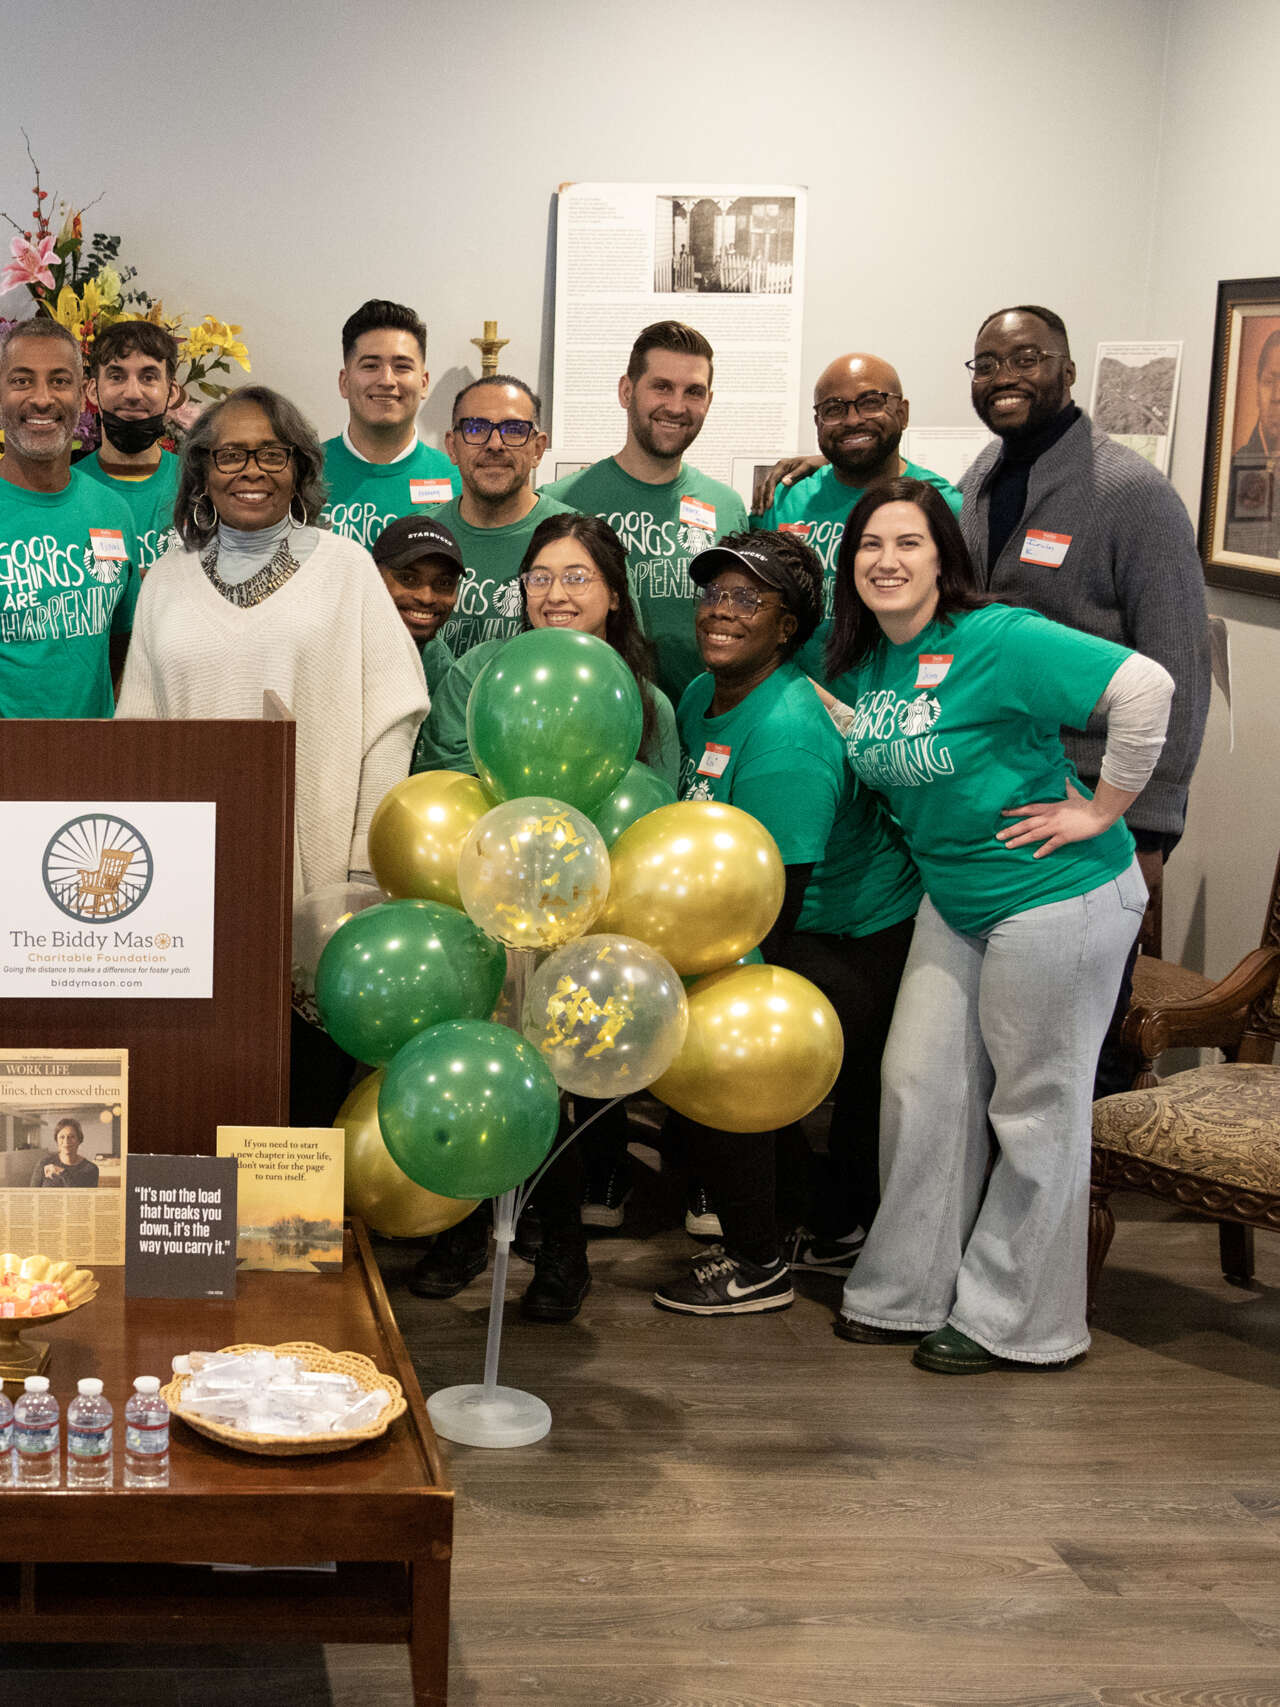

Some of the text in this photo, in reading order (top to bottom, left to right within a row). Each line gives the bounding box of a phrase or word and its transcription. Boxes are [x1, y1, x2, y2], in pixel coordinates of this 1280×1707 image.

[407, 531, 453, 547] STARBUCKS
[3, 591, 41, 612] ARE
[10, 931, 185, 951] The Biddy Mason
[28, 952, 167, 963] Charitable Foundation
[3, 966, 24, 975] Going
[26, 966, 37, 974] the
[38, 966, 67, 974] distance
[68, 966, 75, 974] to
[77, 966, 96, 974] make
[102, 966, 137, 974] difference
[137, 966, 148, 974] for
[149, 966, 169, 974] foster
[170, 966, 191, 976] youth
[51, 978, 143, 989] biddymason.com
[6, 1064, 70, 1075] WORK LIFE
[30, 1084, 53, 1096] then
[55, 1084, 93, 1096] crossed
[94, 1084, 121, 1096] them
[244, 1139, 319, 1151] If you need to start
[255, 1150, 285, 1161] chapter
[287, 1151, 295, 1159] in
[297, 1152, 315, 1162] your
[316, 1152, 332, 1161] life,
[259, 1161, 276, 1170] wait
[277, 1161, 290, 1170] for
[291, 1162, 304, 1170] the
[305, 1164, 324, 1173] page
[159, 1188, 176, 1203] not
[178, 1187, 197, 1203] the
[198, 1188, 222, 1204] load
[140, 1204, 222, 1222] that breaks you
[140, 1221, 211, 1238] down, it's the
[140, 1240, 161, 1255] way
[163, 1240, 183, 1255] you
[185, 1241, 212, 1256] carry
